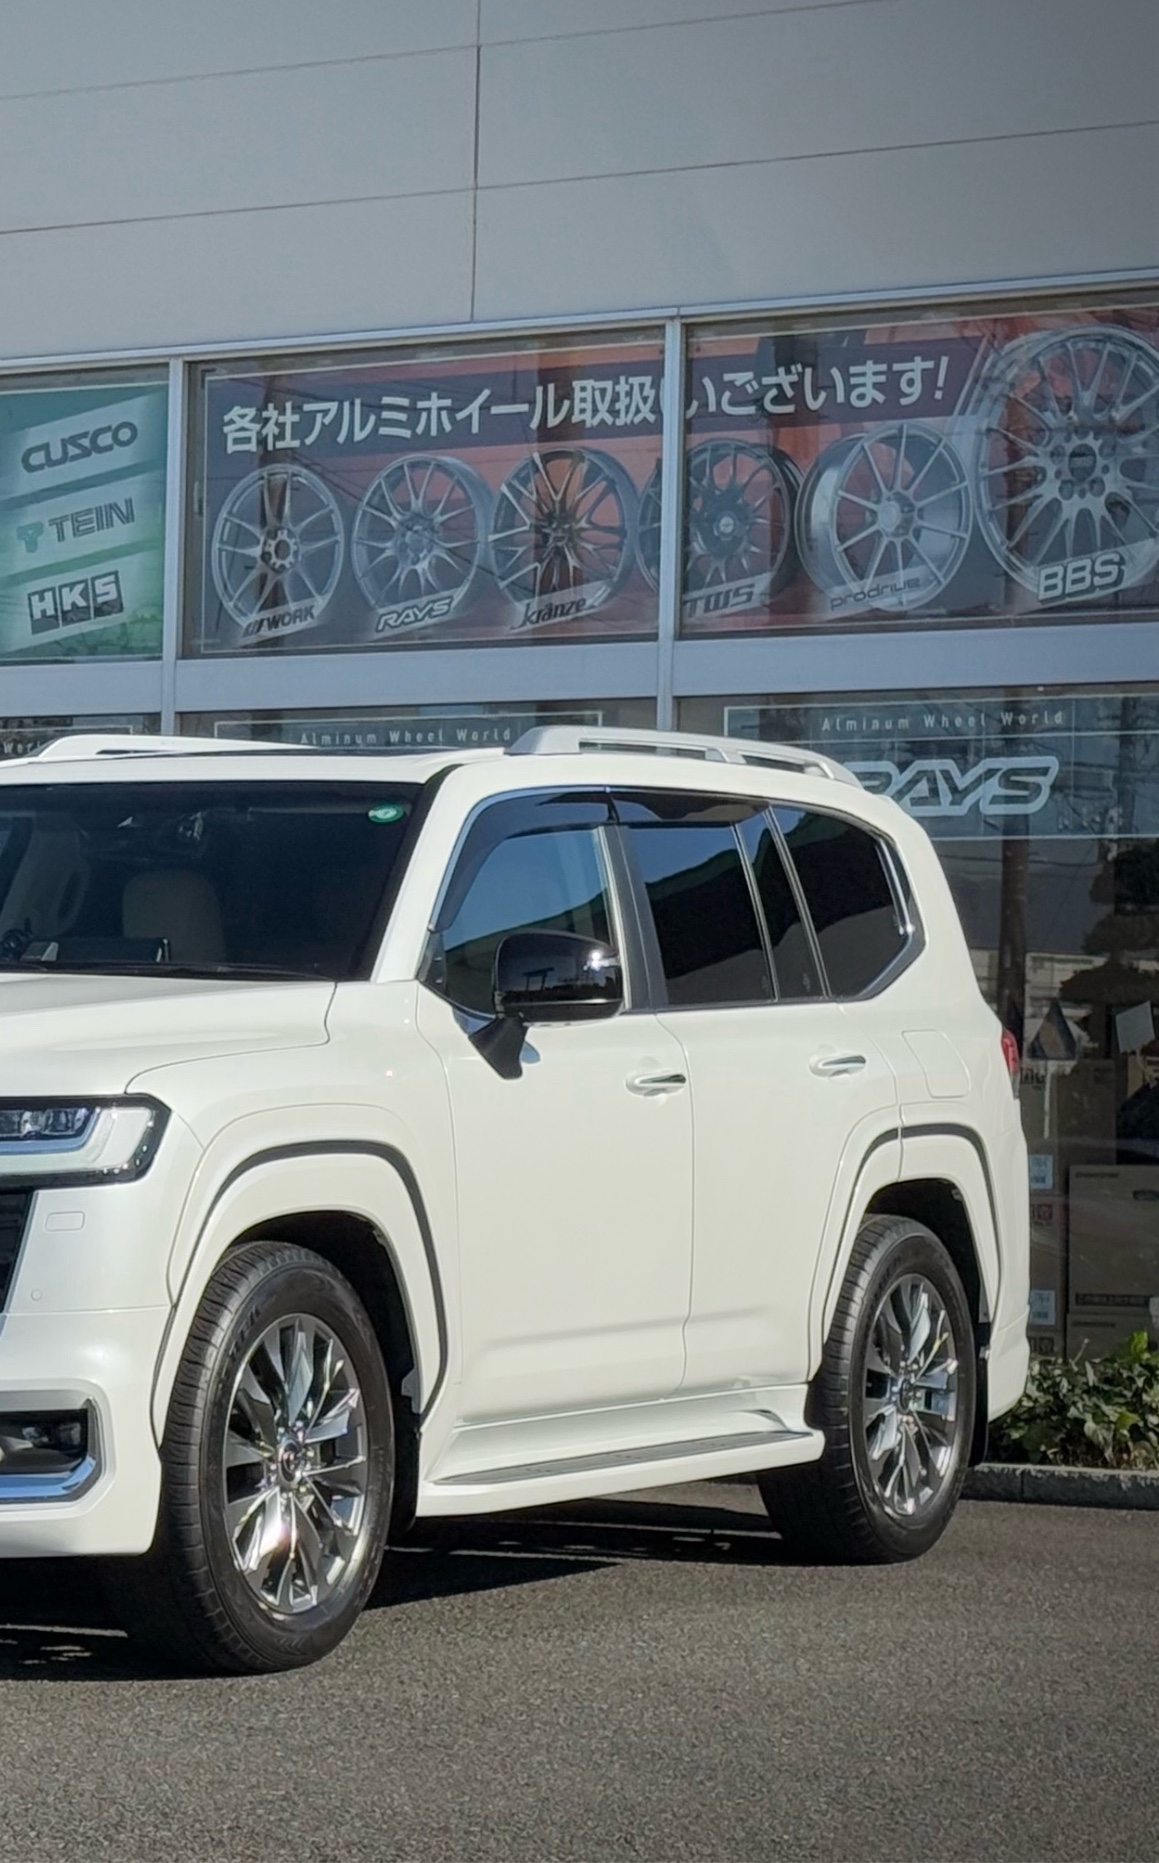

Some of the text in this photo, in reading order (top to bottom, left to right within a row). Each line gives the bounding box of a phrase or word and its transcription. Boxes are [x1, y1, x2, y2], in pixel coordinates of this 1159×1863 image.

[22, 421, 138, 473] CUSCO
[48, 497, 135, 543] TEIN
[1039, 552, 1124, 602] BBS
[29, 571, 123, 631] HKS
[263, 605, 316, 632] WORK
[375, 597, 454, 633] RAYS
[682, 583, 755, 618] TWS
[389, 729, 443, 744] Wheel
[456, 727, 511, 742] World
[924, 713, 986, 729] Wheel
[1001, 711, 1064, 726] World
